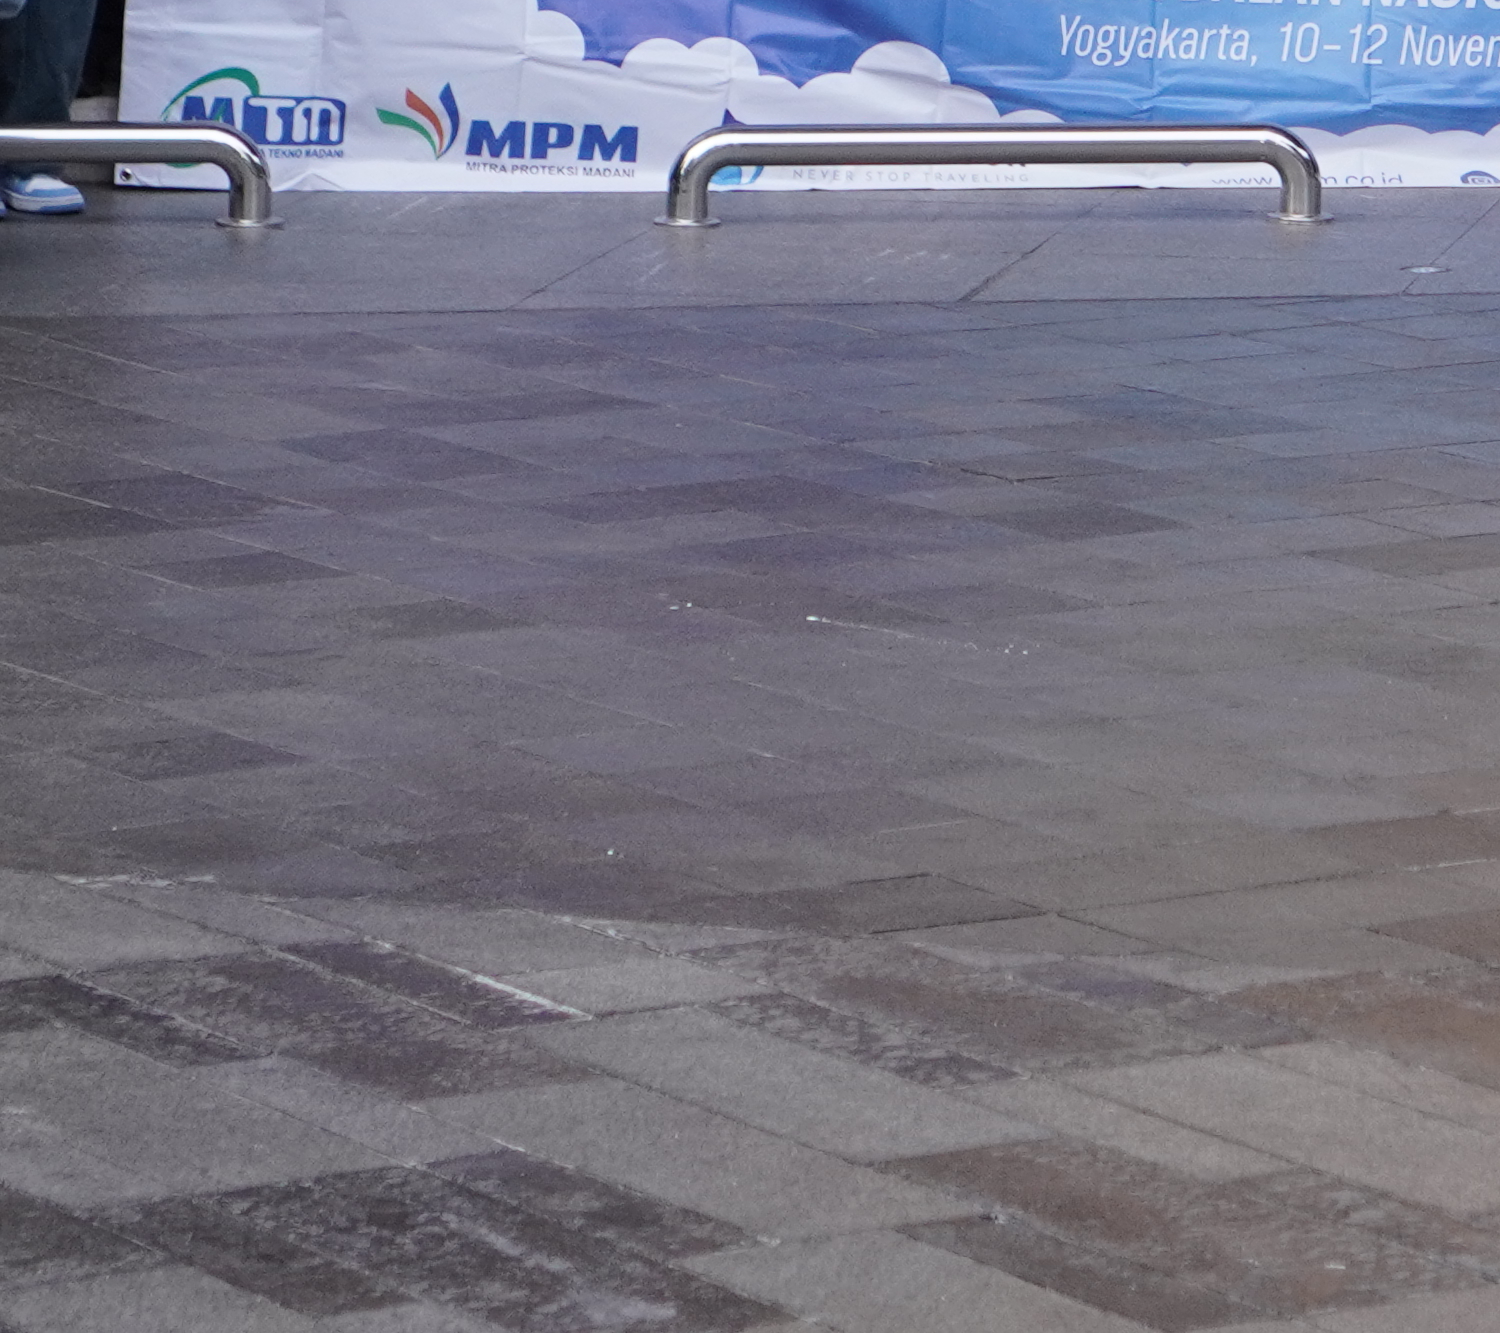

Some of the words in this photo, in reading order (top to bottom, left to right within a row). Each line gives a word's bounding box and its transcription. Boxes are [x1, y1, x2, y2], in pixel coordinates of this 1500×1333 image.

[1058, 14, 1257, 68] Yogyakarta,
[465, 119, 639, 163] MPM
[269, 148, 302, 158] TEKNO
[304, 149, 344, 159] MADANI
[466, 161, 508, 174] MITRA
[510, 163, 579, 177] PROTEKSI
[582, 166, 635, 178] MADANI
[792, 169, 854, 182] NEVER
[866, 170, 911, 182] STOP
[923, 171, 1029, 183] TRAVELING
